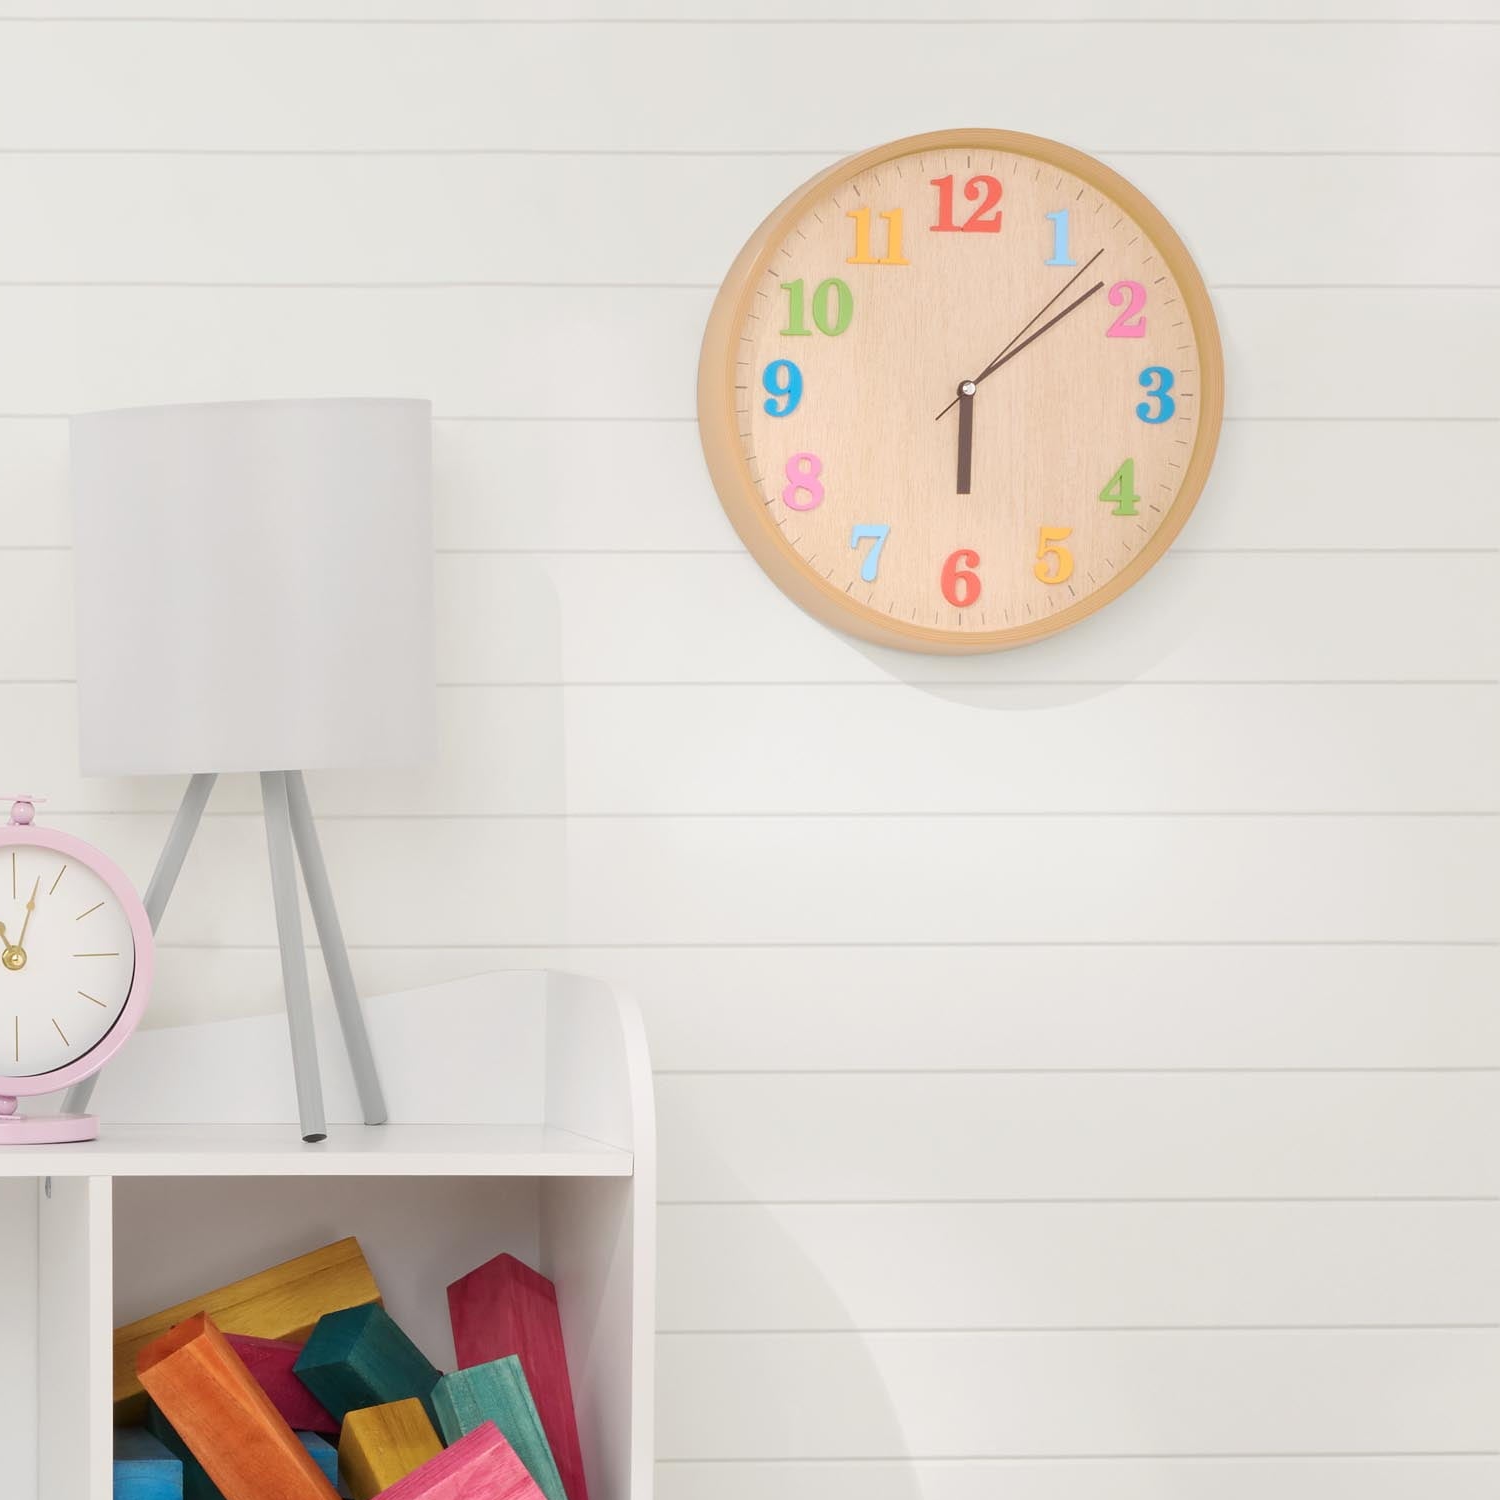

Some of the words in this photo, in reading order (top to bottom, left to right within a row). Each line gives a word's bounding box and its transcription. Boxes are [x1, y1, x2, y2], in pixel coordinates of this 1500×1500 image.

[930, 175, 1003, 232] 12
[846, 207, 910, 265] 11
[1045, 210, 1077, 266] 1
[780, 278, 854, 336] 10
[1106, 281, 1147, 338] 2
[762, 360, 803, 417] 9
[1136, 367, 1176, 424] 3
[783, 453, 825, 511] 8
[1099, 458, 1141, 516] 4
[850, 525, 890, 582] 7
[941, 549, 982, 608] 6
[1034, 527, 1075, 584] 5
